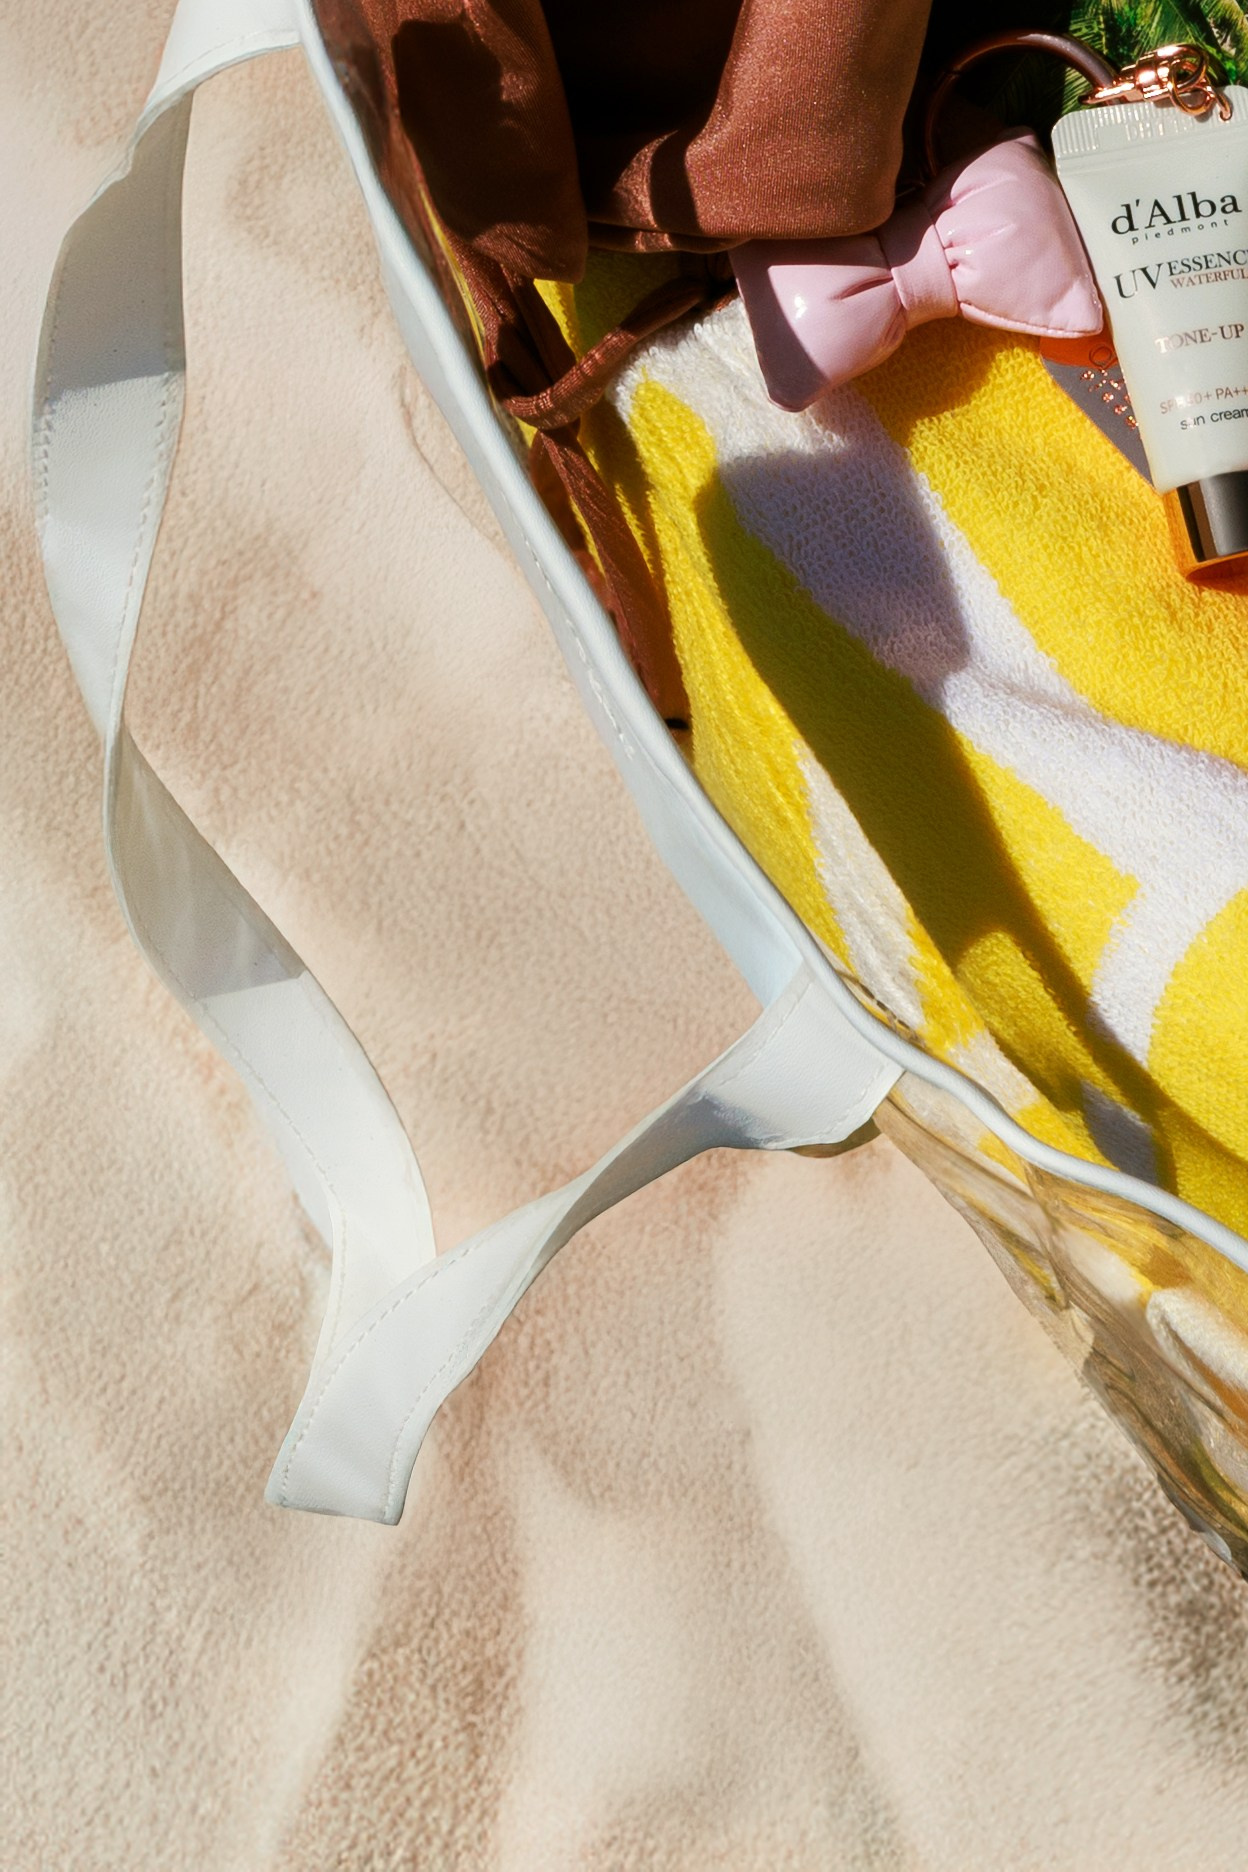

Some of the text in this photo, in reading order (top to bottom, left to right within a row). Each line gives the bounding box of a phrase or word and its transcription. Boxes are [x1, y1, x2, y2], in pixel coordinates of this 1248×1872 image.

[1111, 191, 1242, 235] d'Alba
[1131, 219, 1229, 245] piedmont
[1113, 263, 1165, 299] UV
[1155, 323, 1245, 353] TONE-UP
